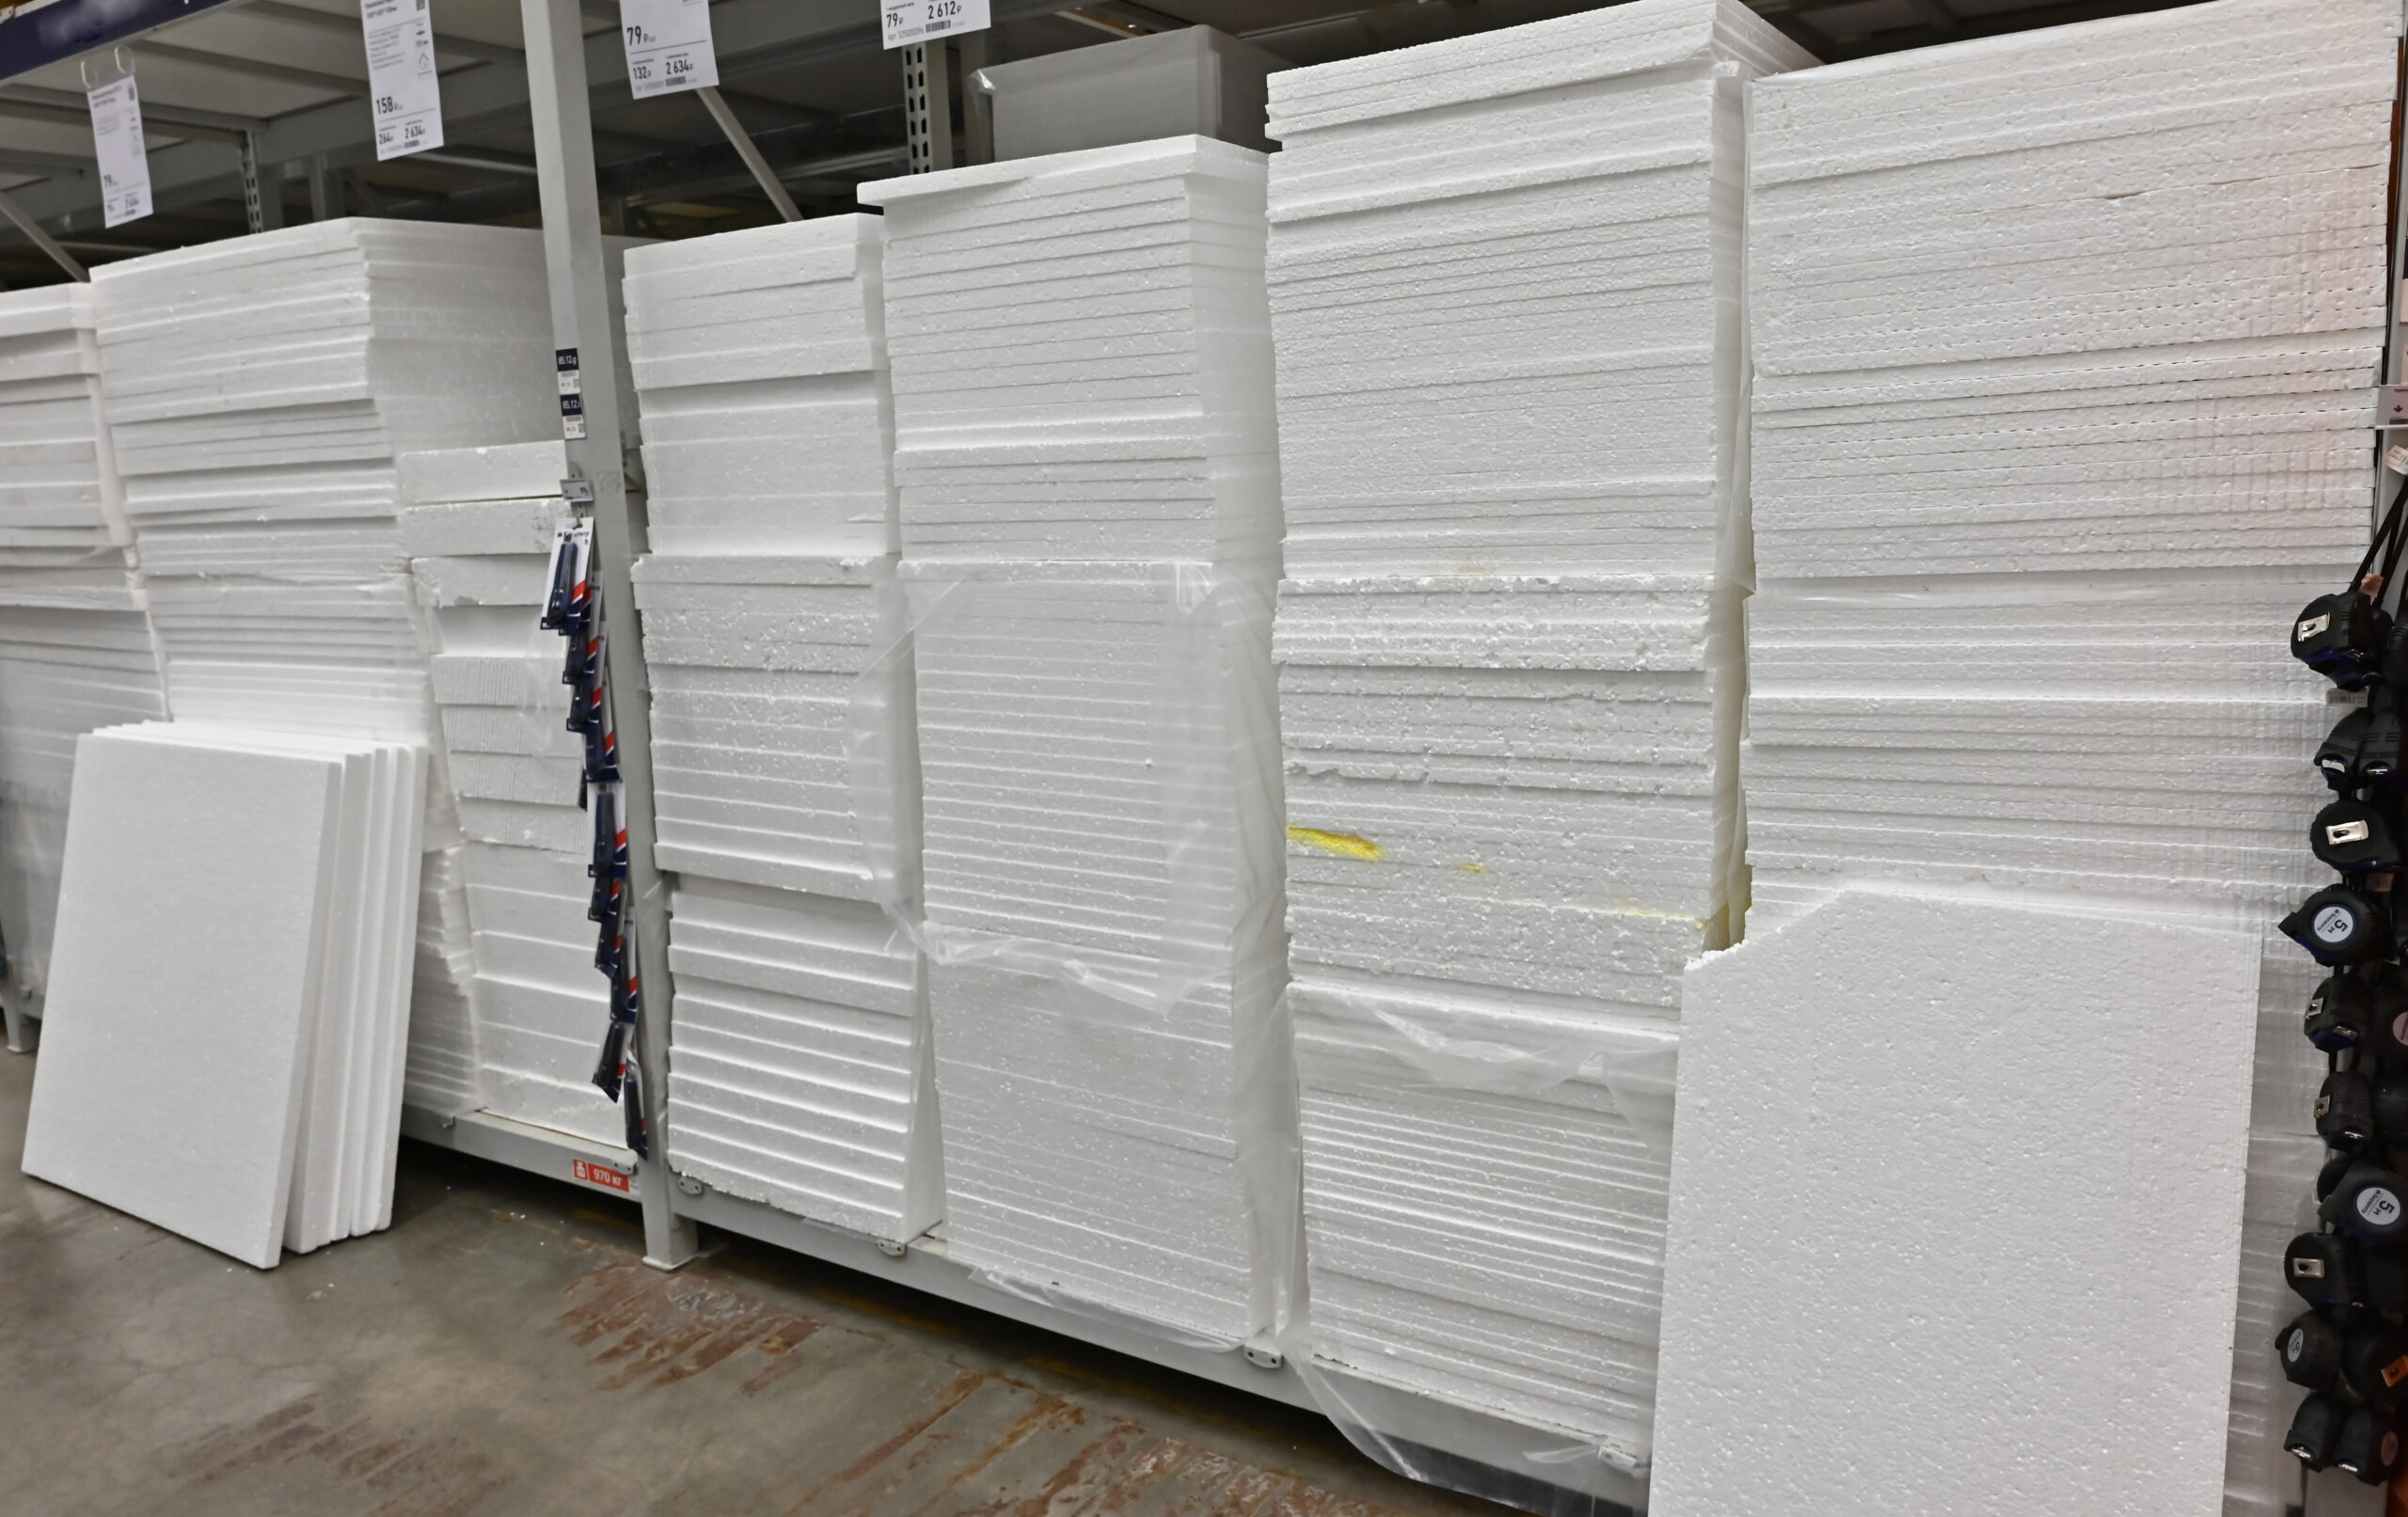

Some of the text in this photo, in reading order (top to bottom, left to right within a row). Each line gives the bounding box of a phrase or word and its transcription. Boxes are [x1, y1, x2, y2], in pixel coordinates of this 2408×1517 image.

[927, 5, 934, 20] 2
[665, 61, 672, 75] 2
[2334, 919, 2349, 932] 5
[2379, 1200, 2396, 1213] 5
